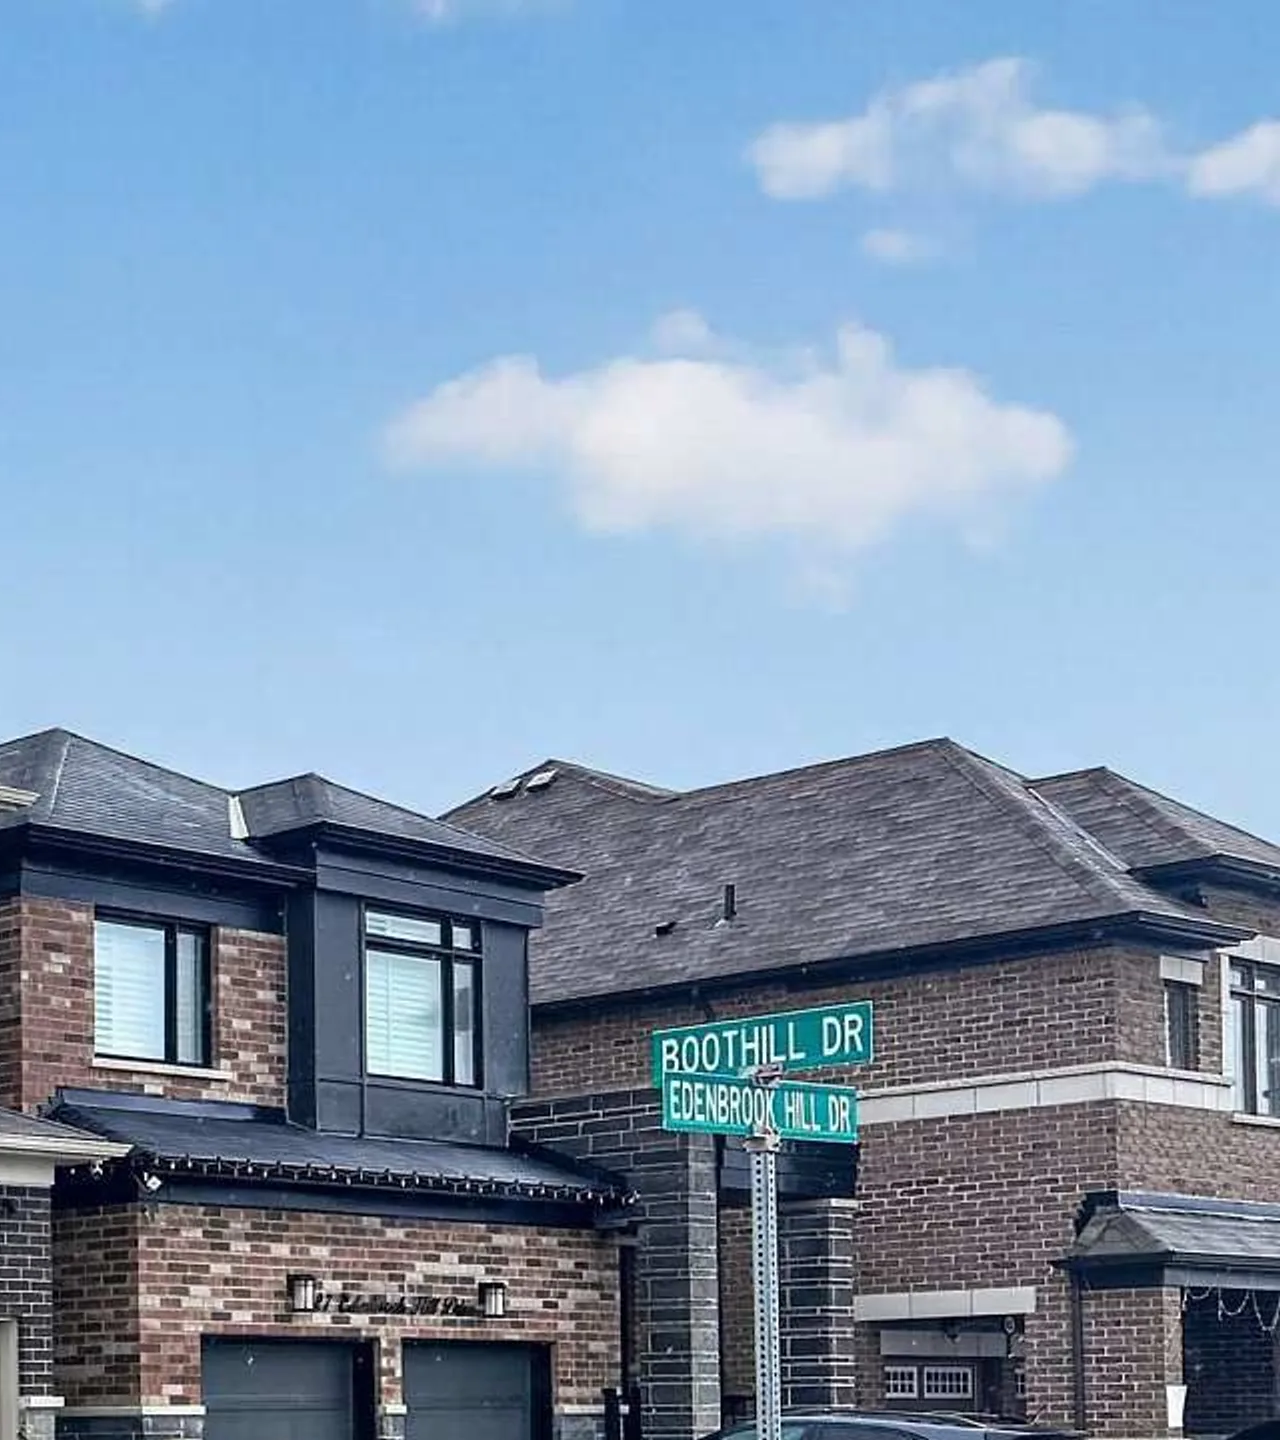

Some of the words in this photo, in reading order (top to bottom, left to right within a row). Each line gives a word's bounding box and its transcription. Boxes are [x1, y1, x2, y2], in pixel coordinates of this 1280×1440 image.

[822, 1014, 863, 1056] DR
[669, 1080, 777, 1128] EDENBROOK
[785, 1092, 821, 1132] HILL
[828, 1095, 850, 1132] DR
